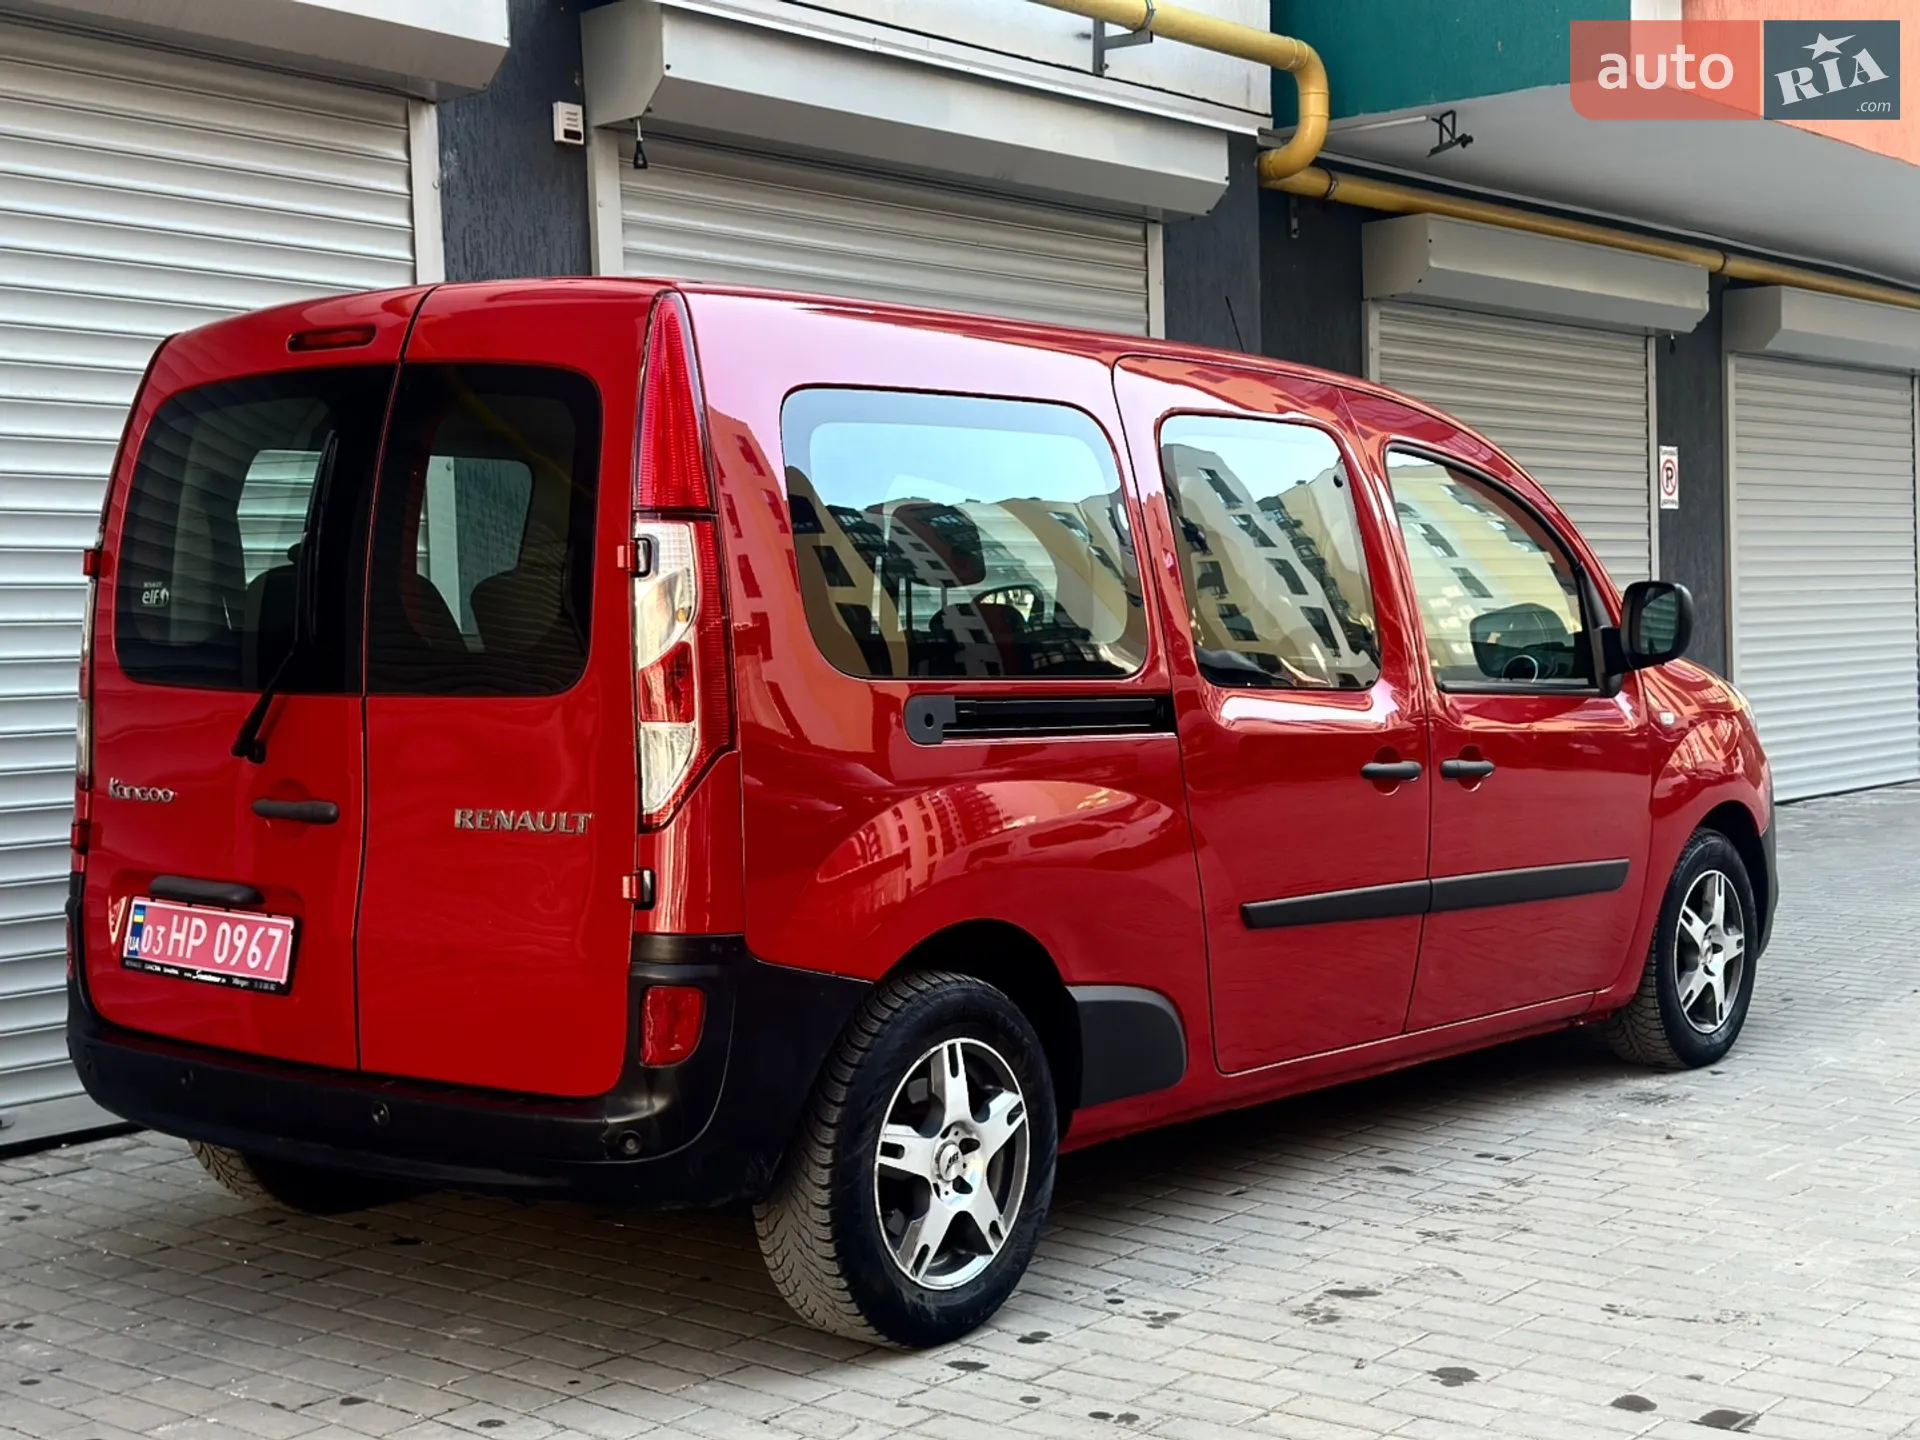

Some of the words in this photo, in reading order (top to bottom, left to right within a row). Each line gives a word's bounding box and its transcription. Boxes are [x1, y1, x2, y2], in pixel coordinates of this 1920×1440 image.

[142, 586, 159, 604] elf
[454, 808, 594, 834] RENAULT
[127, 935, 140, 952] UA
[141, 925, 166, 955] 03
[167, 914, 208, 959] HP
[213, 921, 283, 972] 0967
